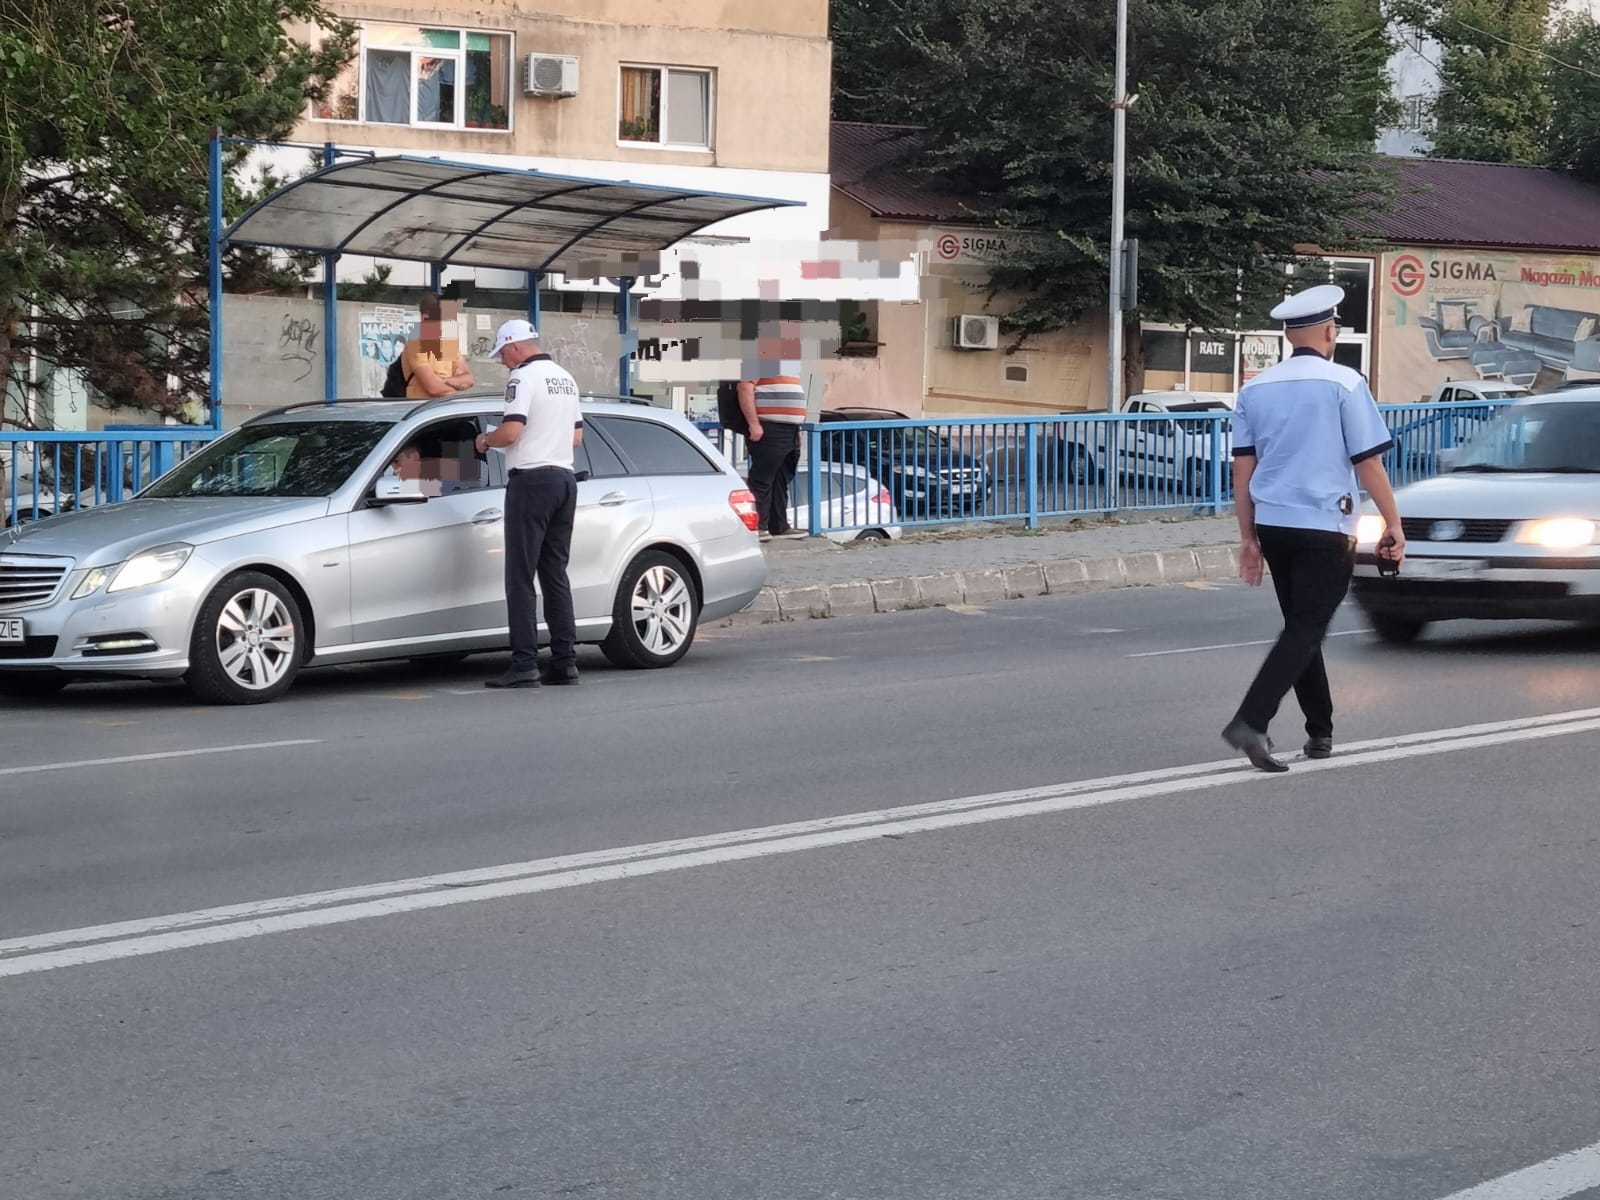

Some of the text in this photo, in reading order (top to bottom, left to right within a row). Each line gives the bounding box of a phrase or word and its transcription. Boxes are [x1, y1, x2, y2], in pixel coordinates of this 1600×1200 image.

[962, 238, 1007, 250] SIGMA
[1429, 261, 1497, 281] SIGMA
[1520, 267, 1576, 287] Magazin
[1200, 341, 1225, 356] RATE
[1242, 342, 1281, 356] MOBILA
